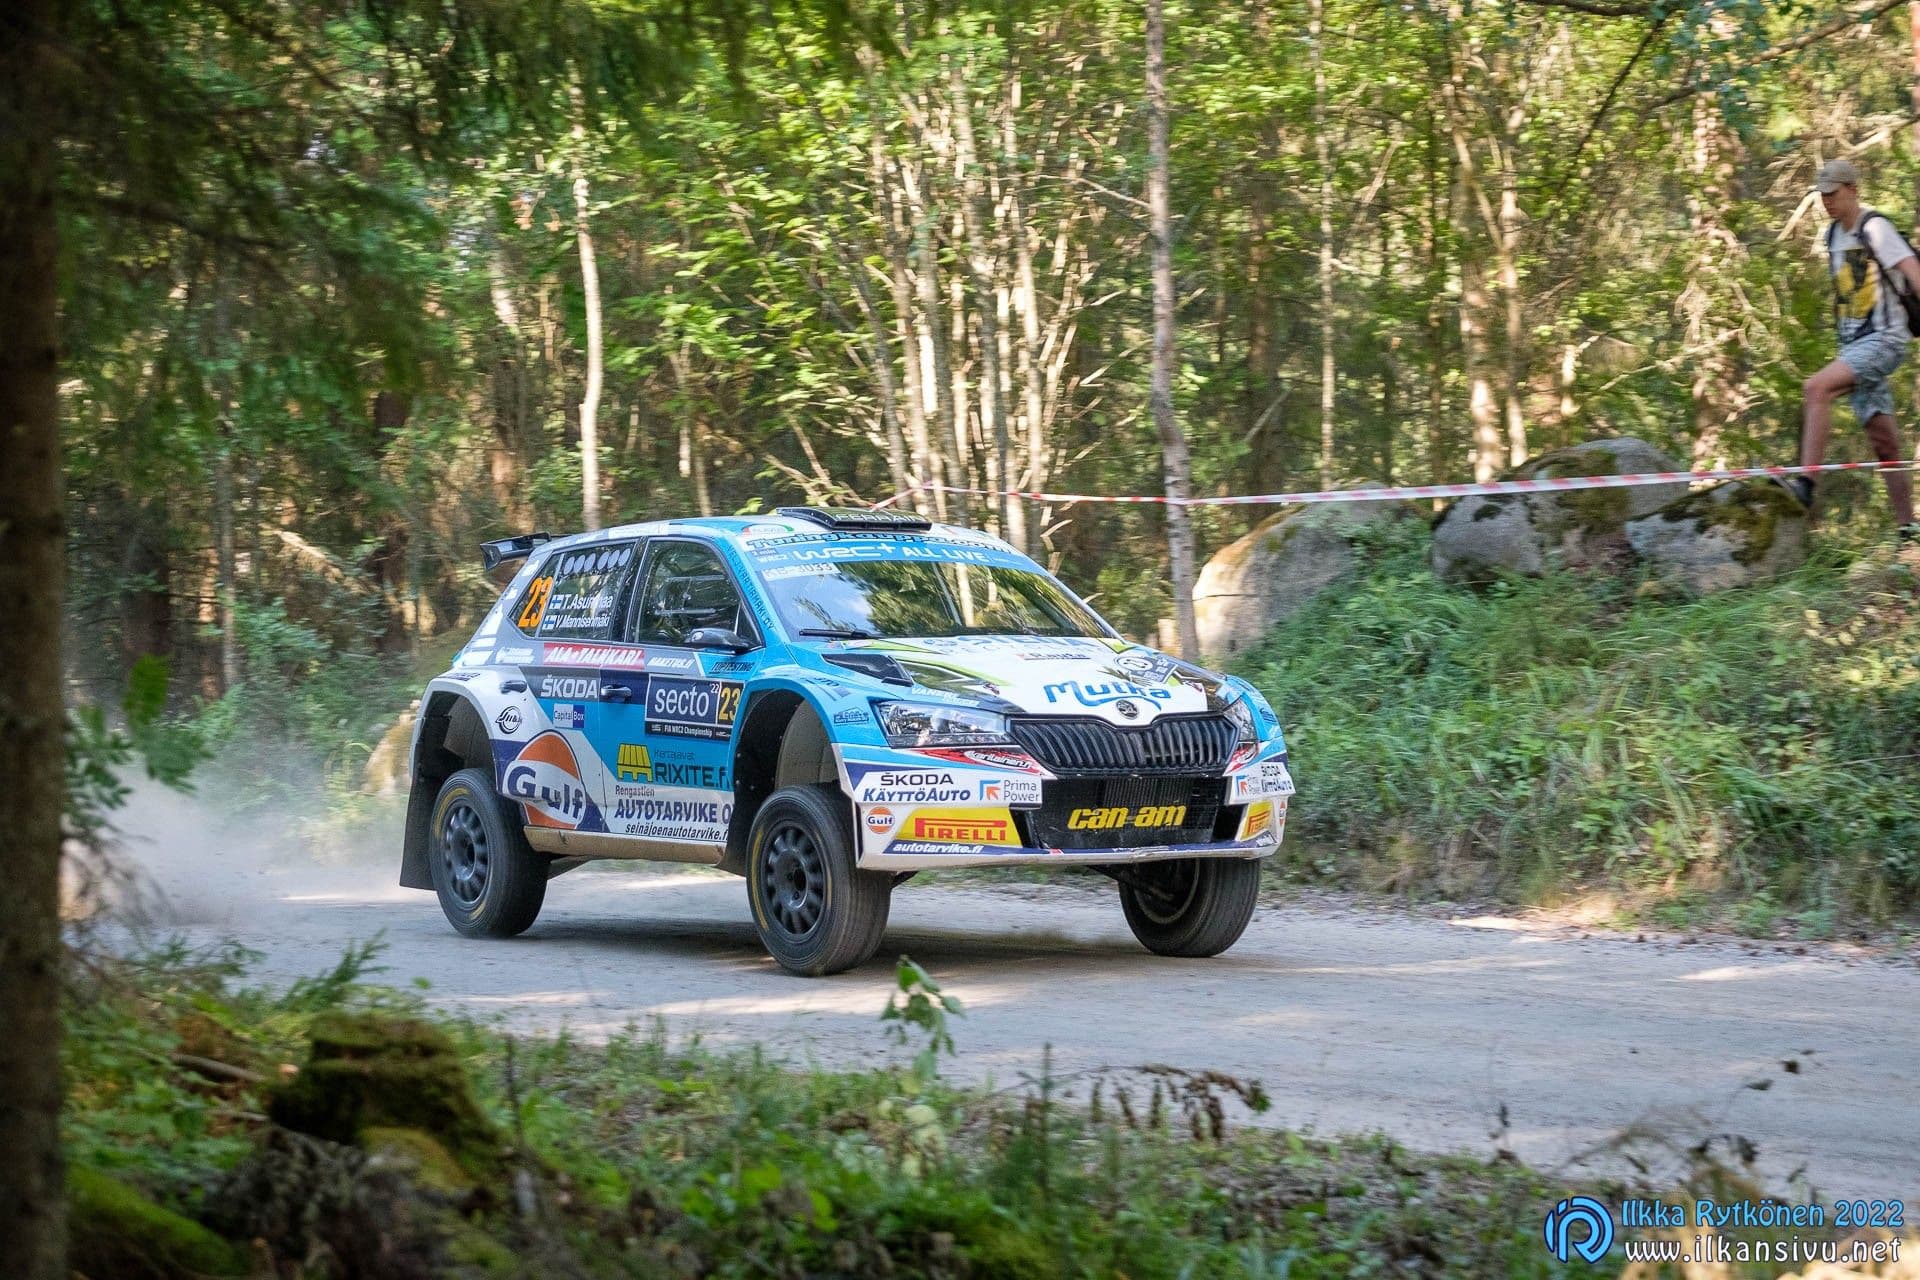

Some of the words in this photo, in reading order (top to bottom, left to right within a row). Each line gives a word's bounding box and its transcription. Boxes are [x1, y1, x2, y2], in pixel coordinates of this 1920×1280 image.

[901, 546, 942, 558] ALL
[942, 549, 990, 561] LIVE
[517, 575, 554, 628] 23
[561, 593, 614, 611] T.Asunaa
[540, 674, 599, 699] ŠKODA
[654, 682, 710, 717] secto
[718, 686, 740, 721] 23
[880, 772, 954, 786] ŠKODA
[1003, 780, 1037, 792] Prima
[507, 765, 584, 820] Gulf
[615, 784, 655, 798] Rengastien
[863, 787, 971, 802] KÄYTTÖAUTO
[1003, 791, 1040, 802] Power
[614, 798, 718, 824] AUTOTARVIKE
[721, 803, 734, 825] O
[867, 816, 893, 826] Gulf
[914, 817, 1008, 841] PIRELLI
[892, 842, 984, 855] autotarvike.fi
